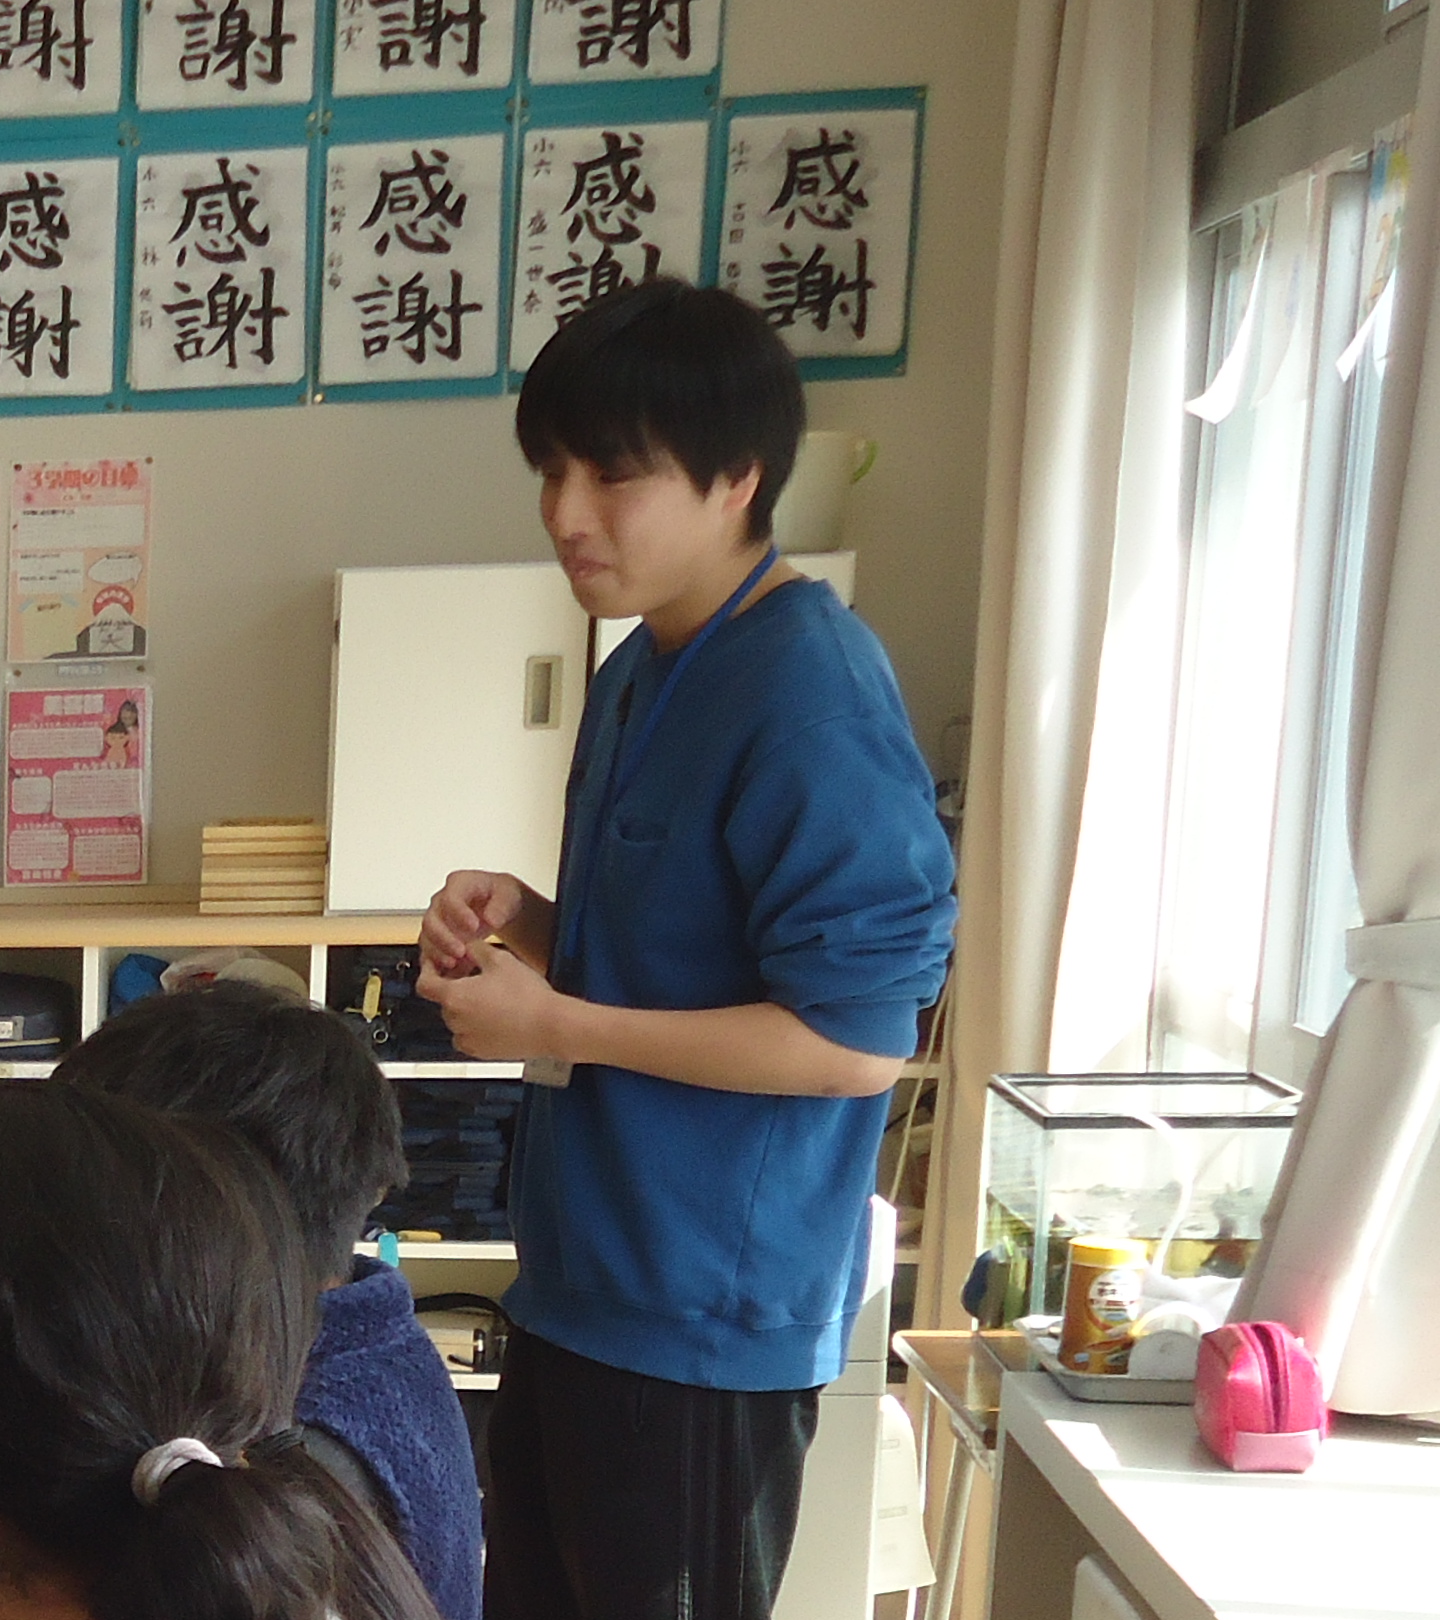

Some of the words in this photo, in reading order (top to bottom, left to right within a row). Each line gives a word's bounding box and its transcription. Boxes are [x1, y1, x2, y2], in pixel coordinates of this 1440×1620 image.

[352, 148, 483, 365] 感謝
[532, 137, 554, 178] 小六
[760, 127, 876, 341] 感謝
[162, 158, 290, 369] 感謝
[29, 467, 139, 489] 3学期の目標
